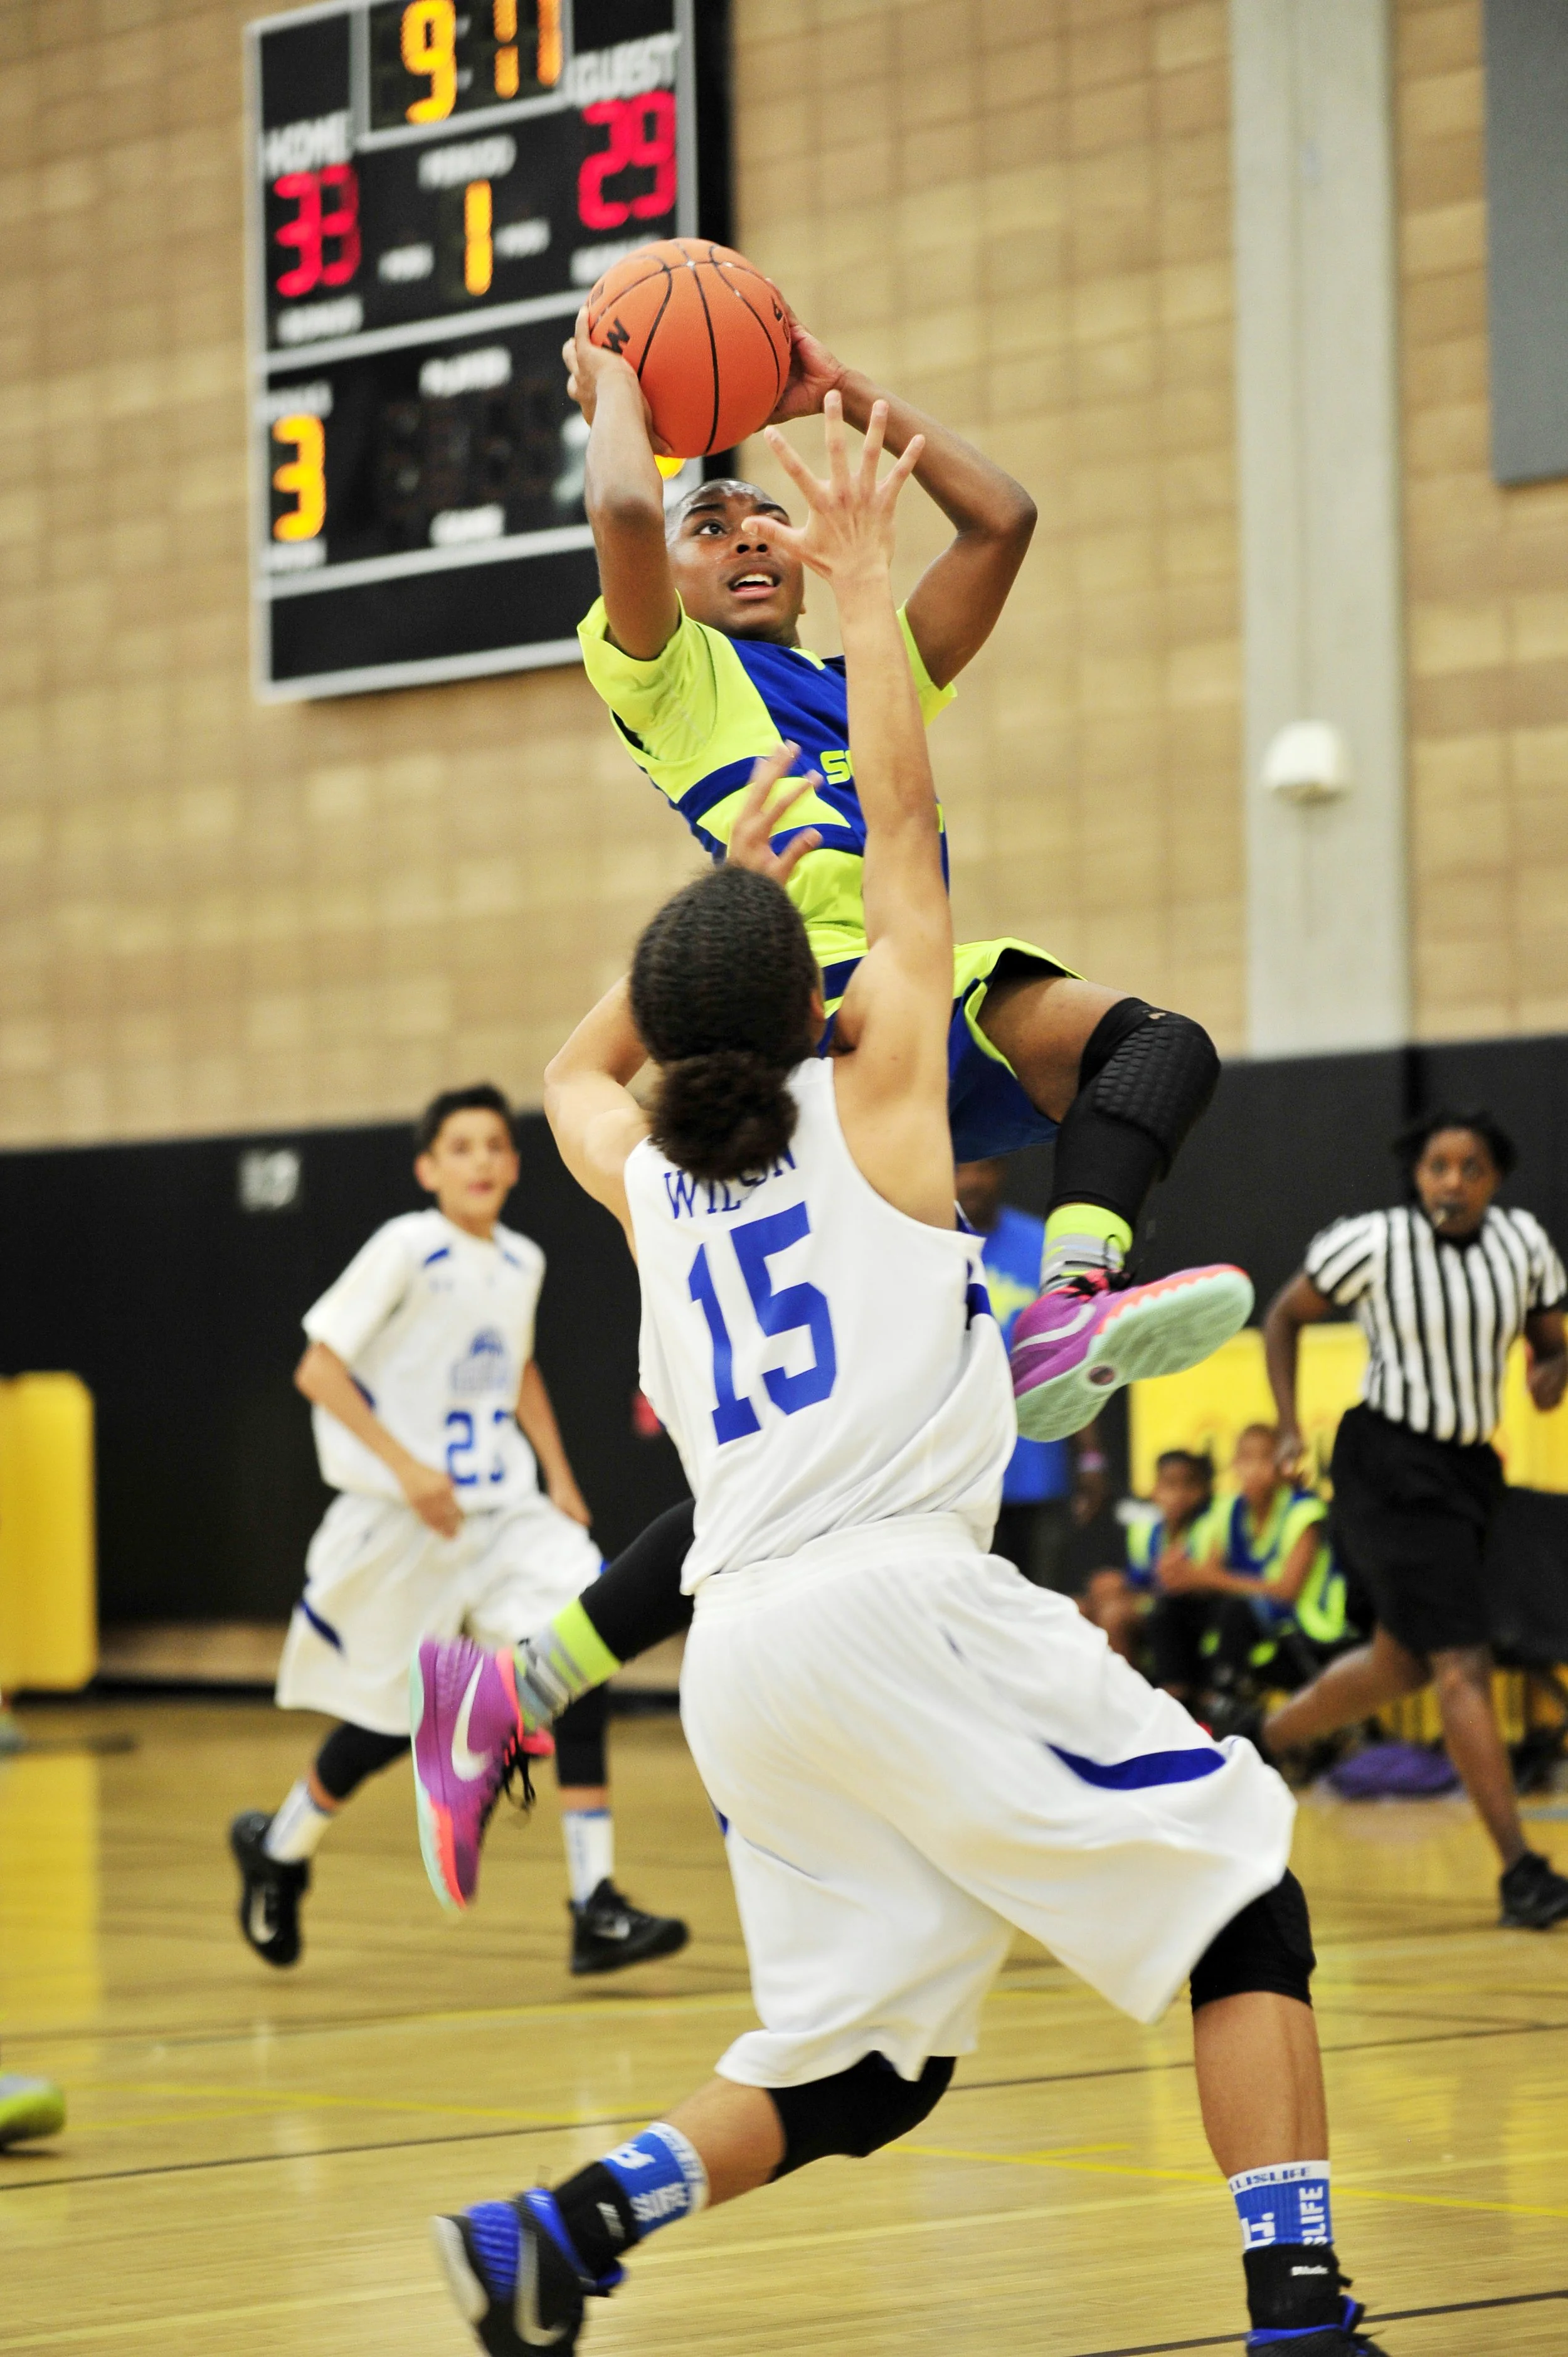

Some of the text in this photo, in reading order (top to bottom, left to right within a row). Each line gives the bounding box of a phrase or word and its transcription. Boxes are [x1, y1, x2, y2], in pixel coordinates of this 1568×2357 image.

[577, 90, 677, 230] 29
[273, 163, 361, 297] 33
[464, 179, 493, 297] 1
[273, 414, 326, 542] 3
[820, 749, 854, 785] S
[688, 1201, 837, 1445] 15
